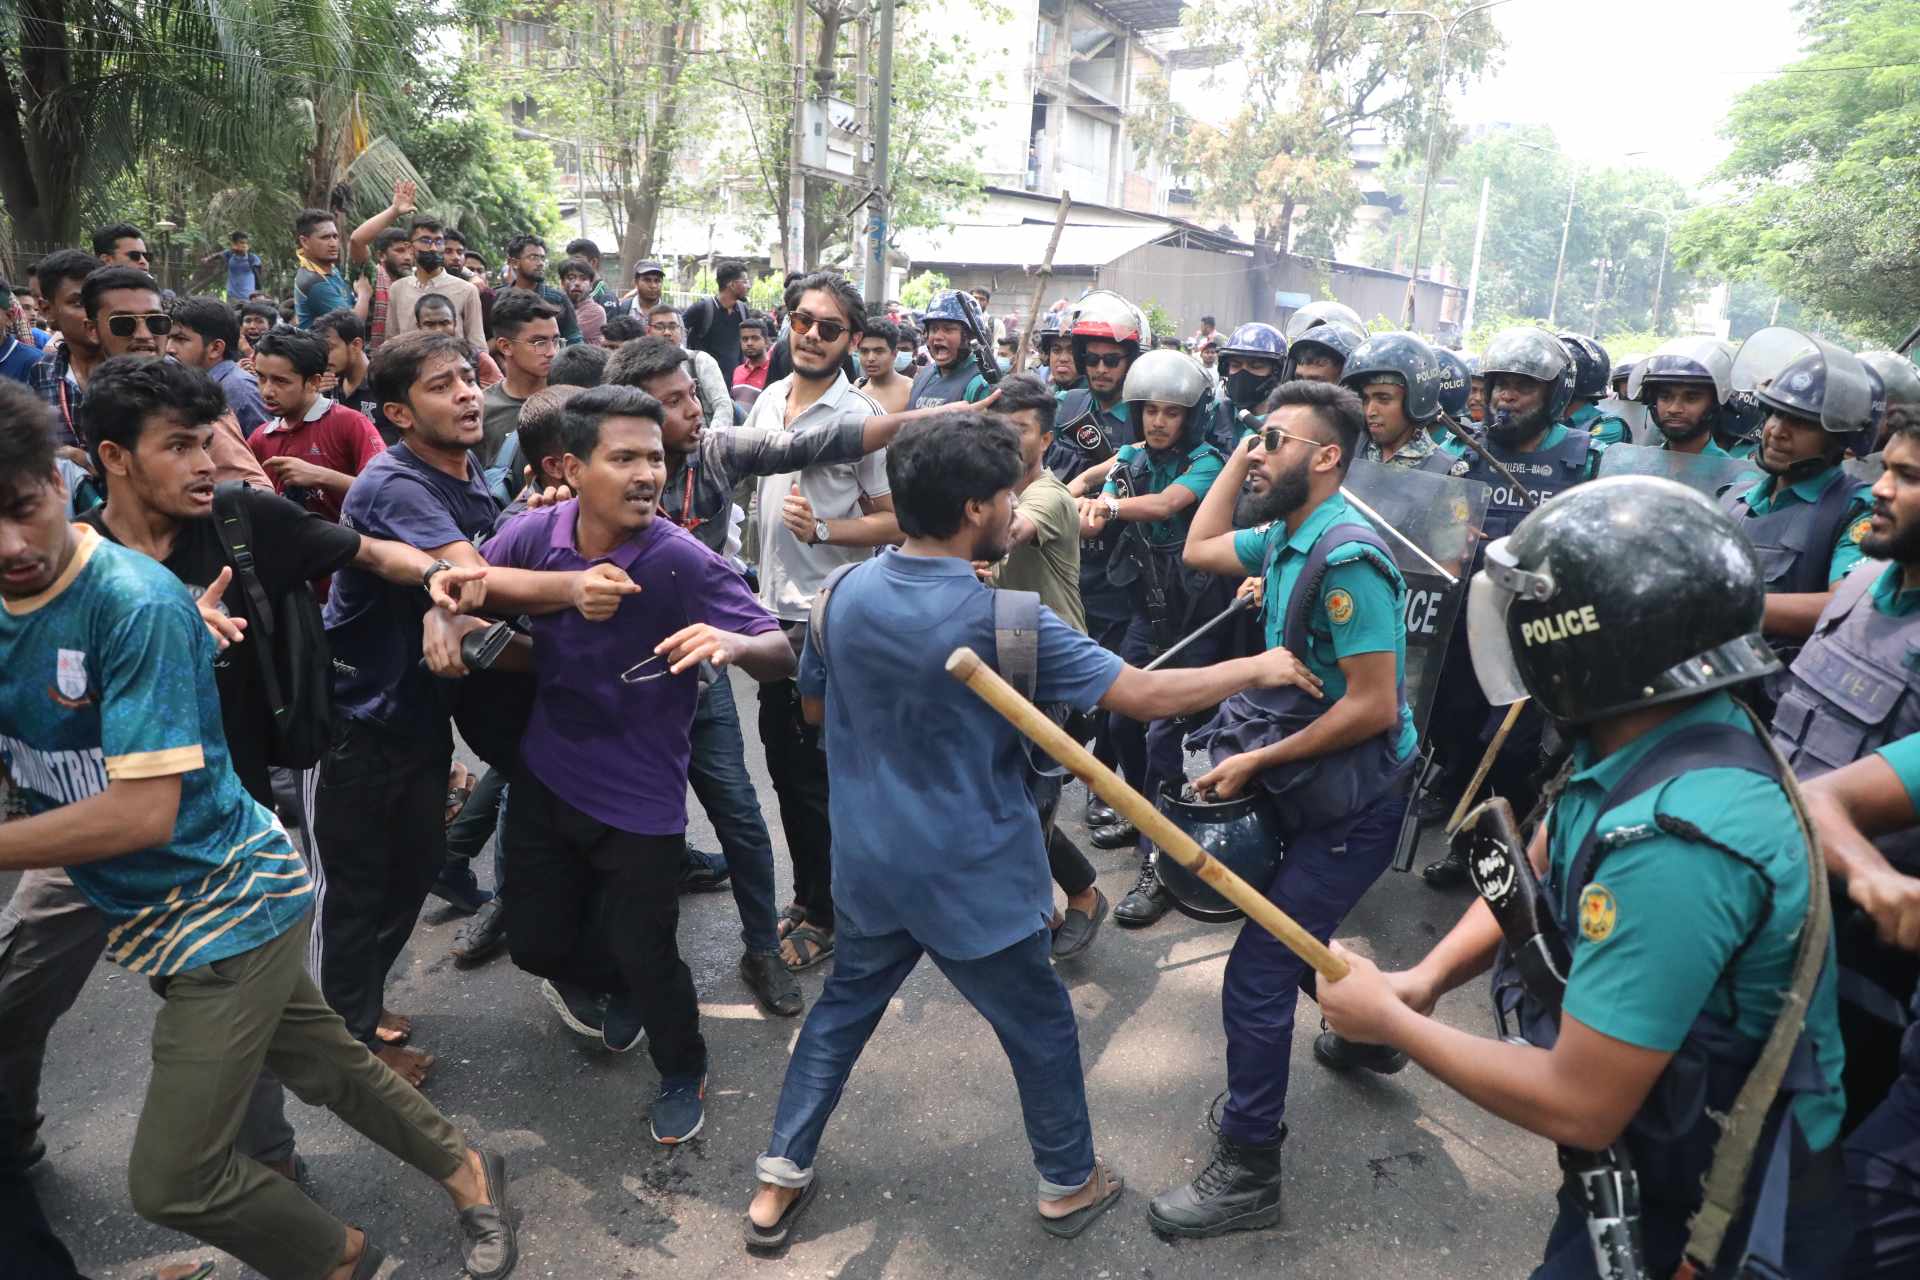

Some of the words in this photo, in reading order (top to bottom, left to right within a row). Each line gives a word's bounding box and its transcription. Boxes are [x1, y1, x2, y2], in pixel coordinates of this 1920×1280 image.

[1439, 379, 1465, 391] POLICE
[1738, 391, 1760, 408] POLI
[1404, 589, 1442, 633] ICE
[1521, 604, 1601, 647] POLICE
